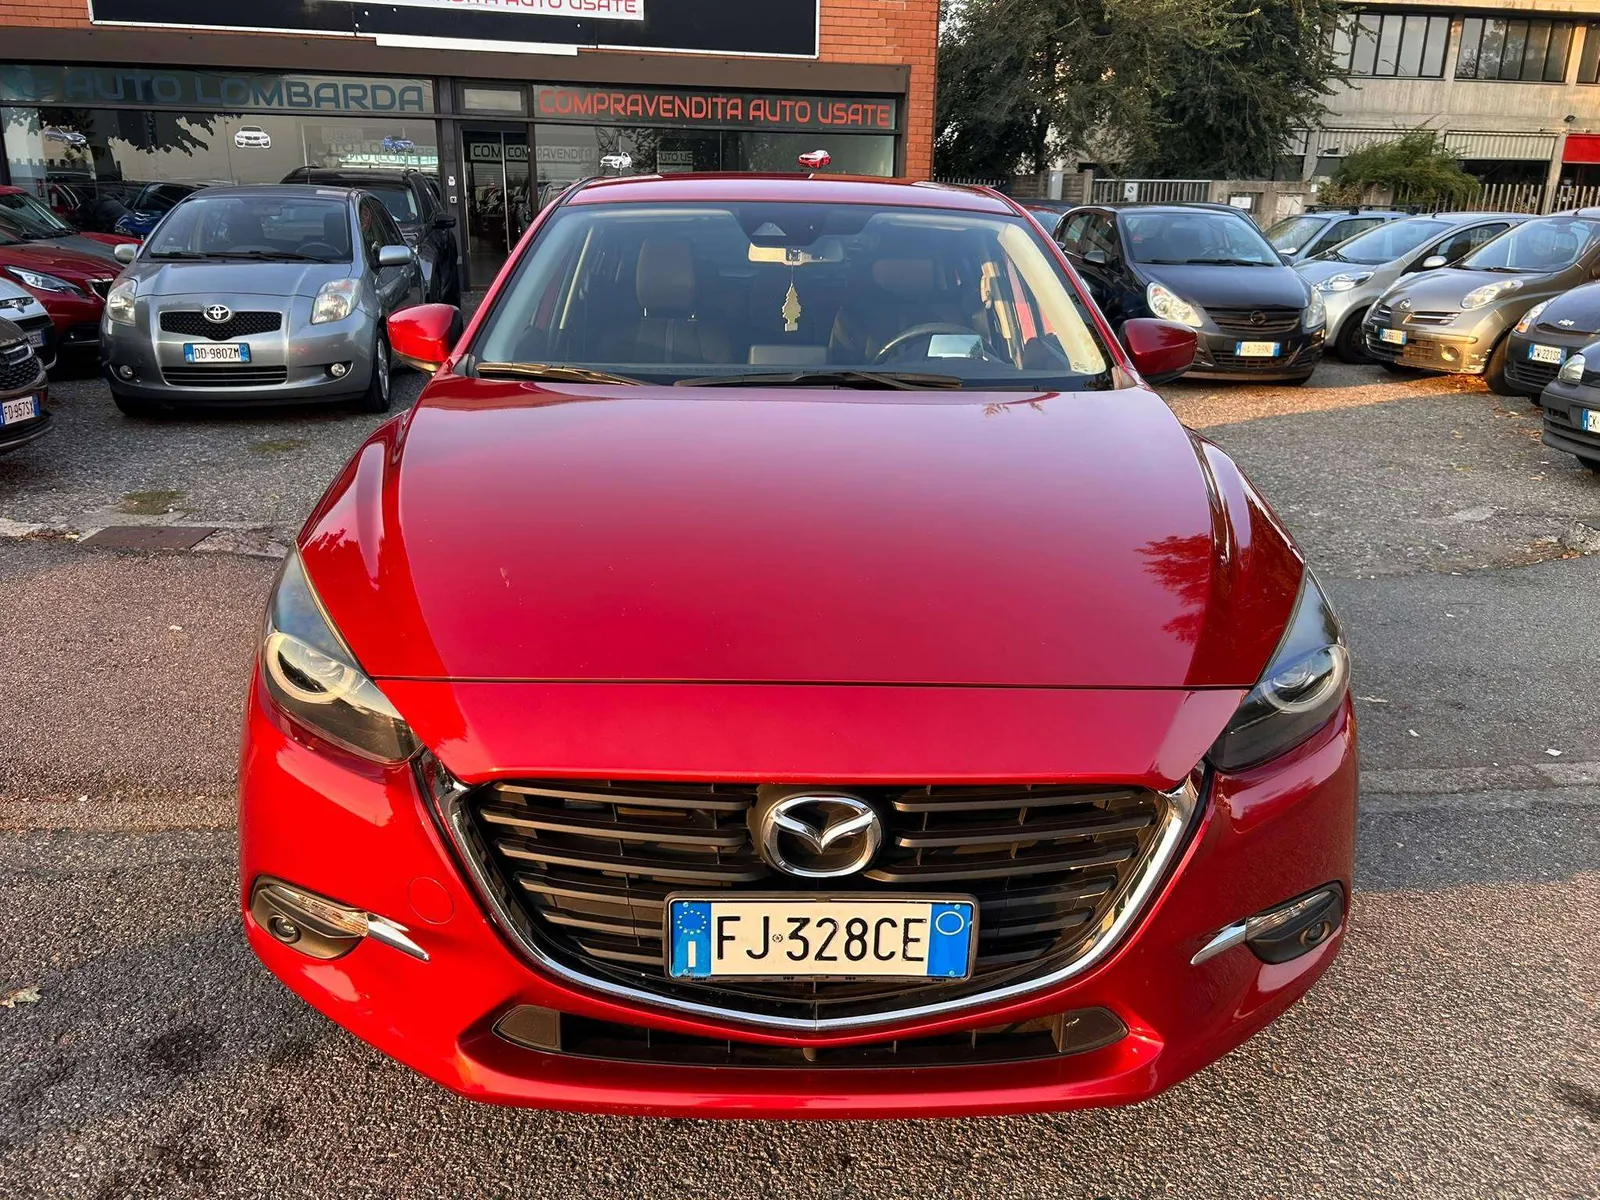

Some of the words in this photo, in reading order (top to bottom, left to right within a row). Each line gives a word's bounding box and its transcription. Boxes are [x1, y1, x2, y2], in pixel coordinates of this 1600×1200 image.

[569, 0, 637, 13] USATE
[65, 72, 182, 101] AUTO
[194, 76, 425, 112] LOMBARDA
[539, 90, 742, 120] COMPRAVENDITA
[750, 99, 811, 123] AUTO
[818, 102, 890, 127] USATE
